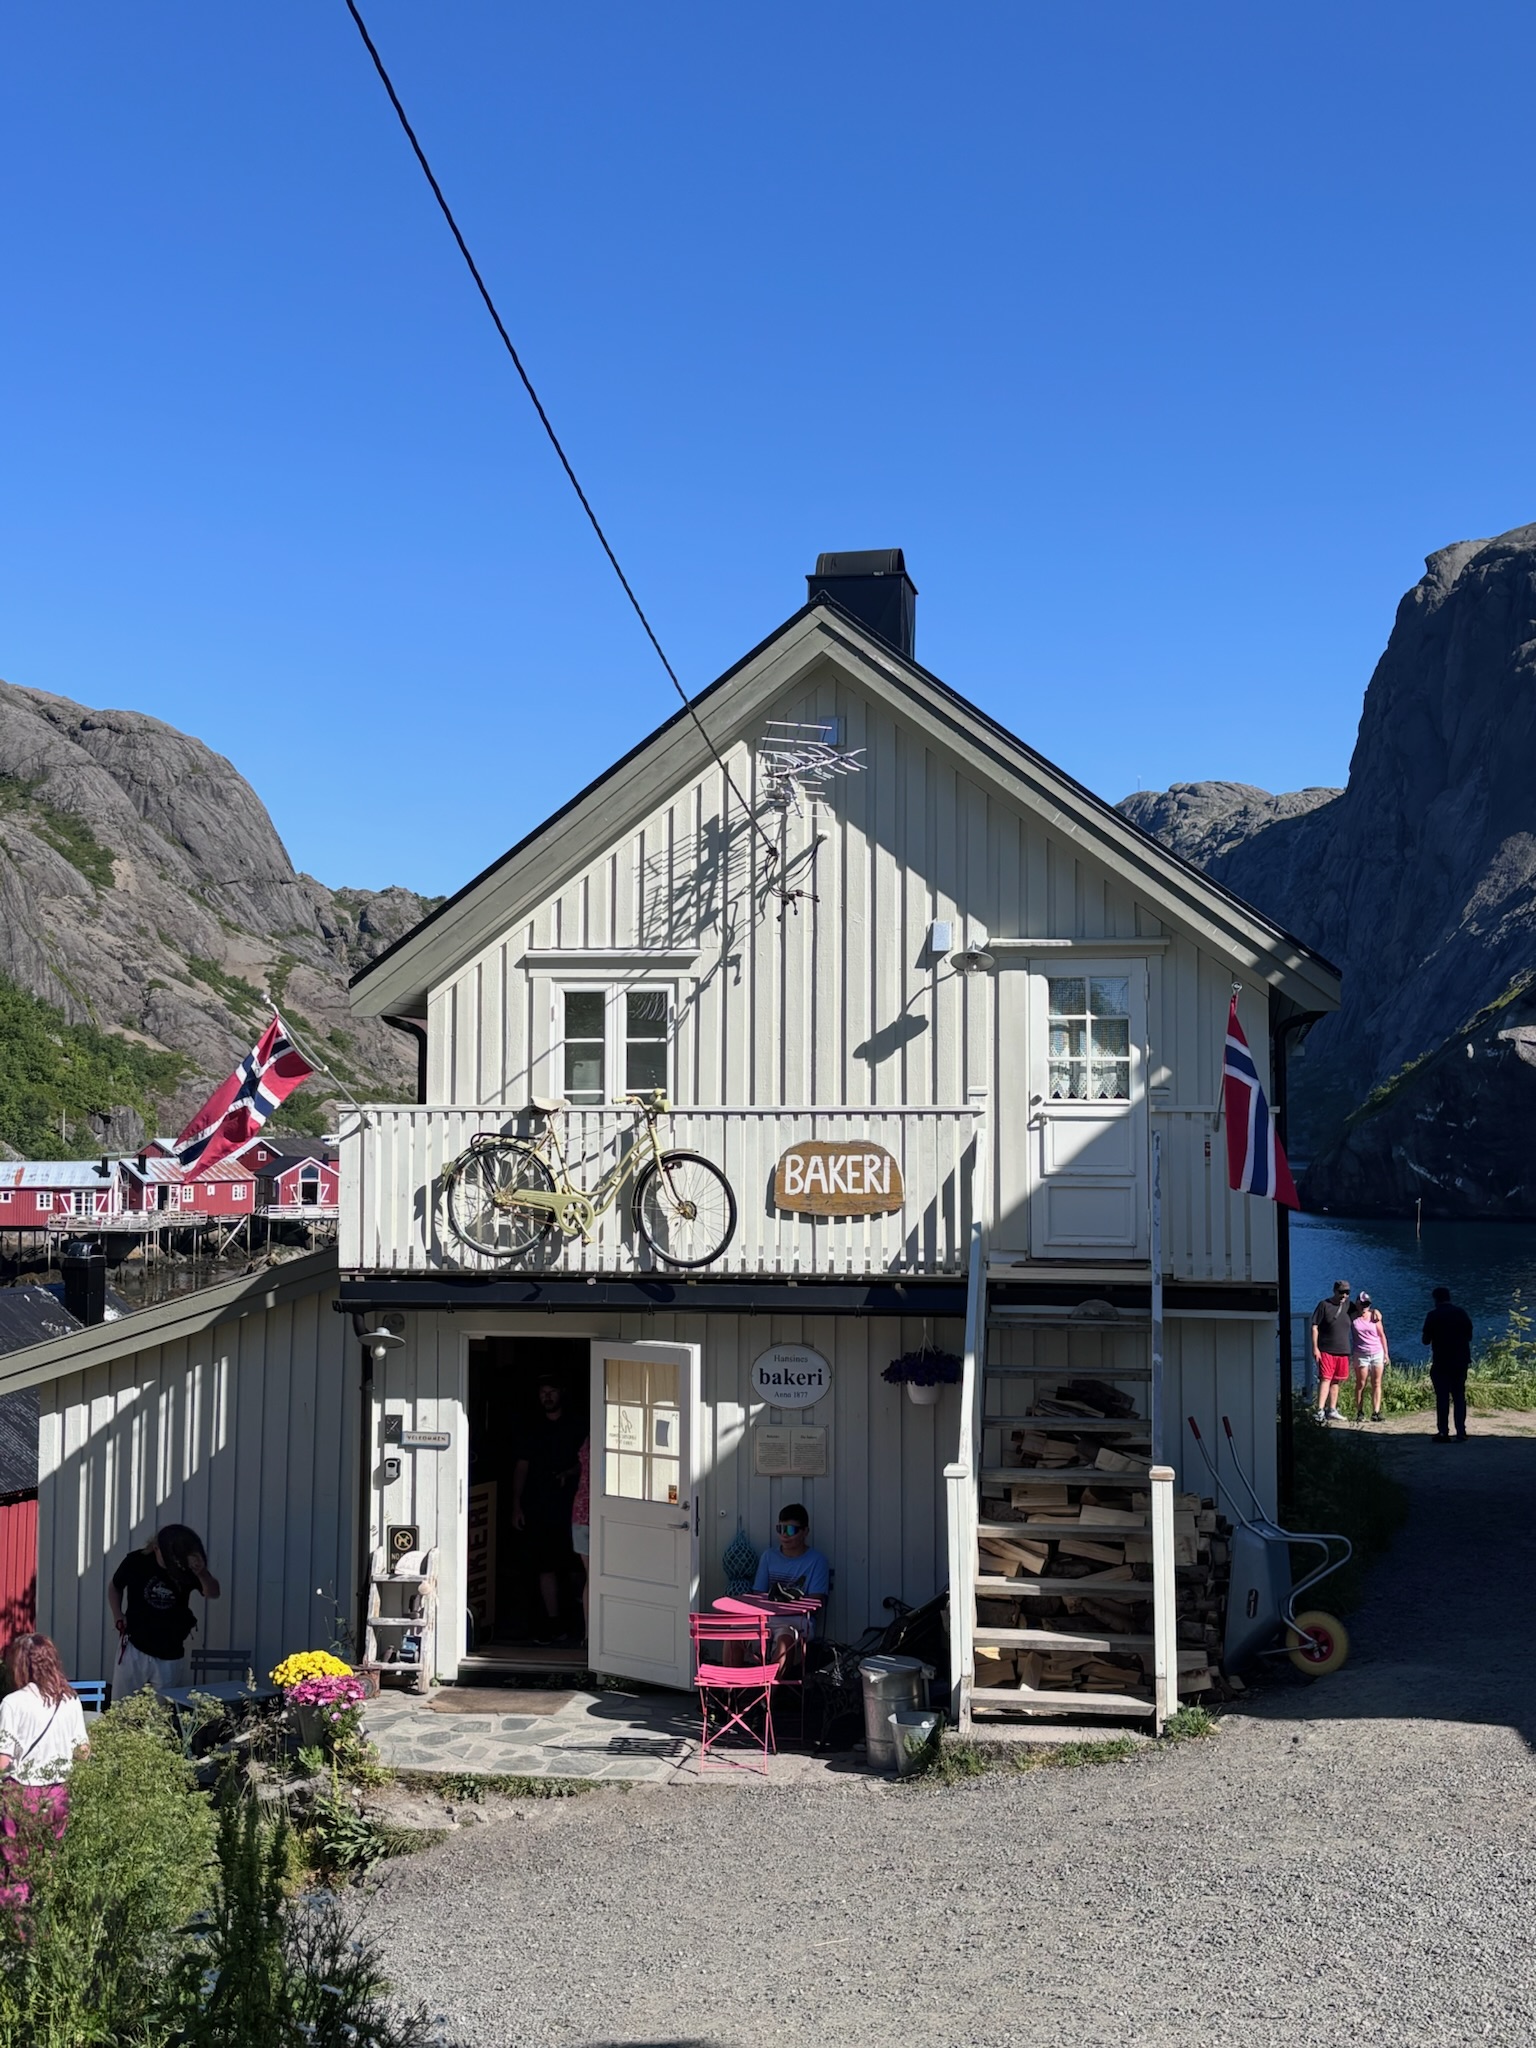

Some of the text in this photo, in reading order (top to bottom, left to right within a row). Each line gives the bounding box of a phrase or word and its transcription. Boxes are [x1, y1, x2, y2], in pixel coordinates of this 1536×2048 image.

[785, 1154, 890, 1195] BAKERI
[773, 1354, 808, 1363] Hansines
[759, 1367, 823, 1386] bakeri
[793, 1391, 808, 1399] 1877
